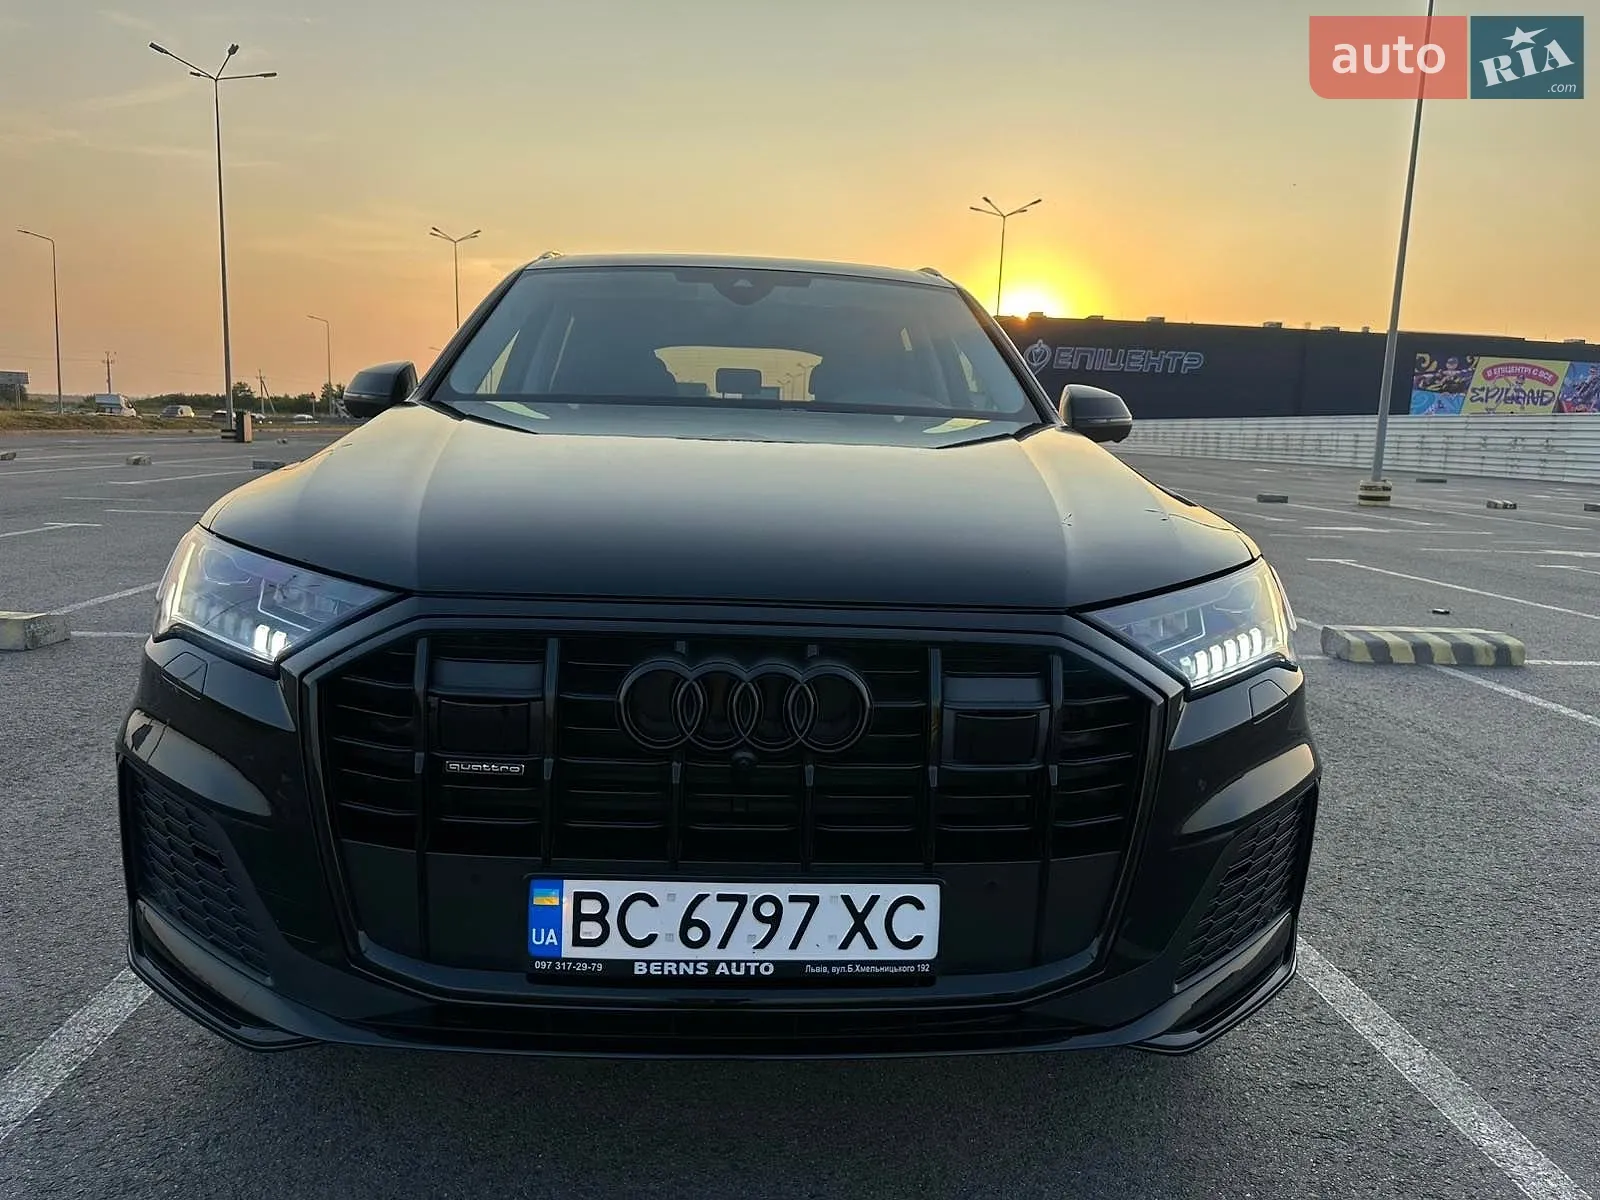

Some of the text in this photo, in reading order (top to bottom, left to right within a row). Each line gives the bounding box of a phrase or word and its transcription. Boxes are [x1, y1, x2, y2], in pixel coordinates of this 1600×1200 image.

[1053, 346, 1204, 374] ЕПІЦЕНТР
[449, 763, 520, 773] quattro
[571, 891, 926, 950] BC 6797 XC
[532, 928, 558, 946] UA
[534, 960, 603, 972] 097 317-29-79
[633, 961, 775, 975] BERNS AUTO
[805, 964, 830, 974] Львів,
[917, 964, 930, 972] 192
